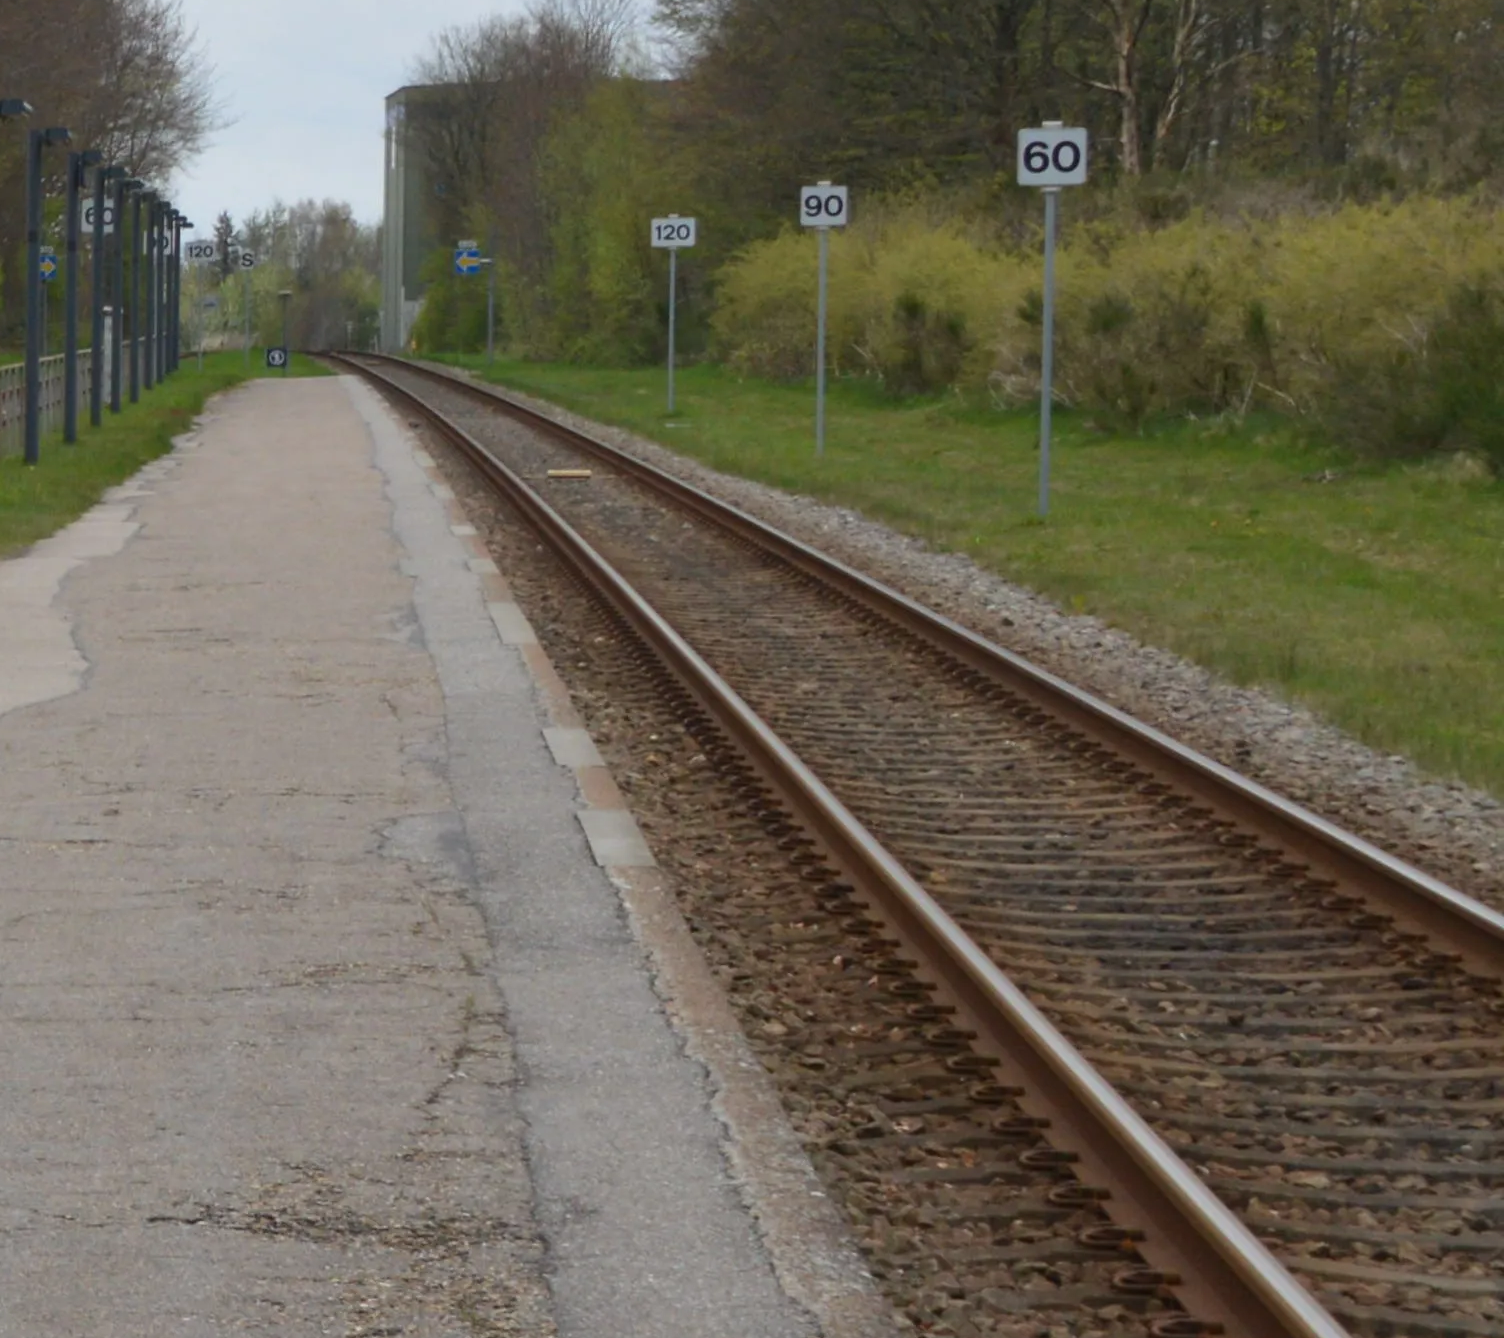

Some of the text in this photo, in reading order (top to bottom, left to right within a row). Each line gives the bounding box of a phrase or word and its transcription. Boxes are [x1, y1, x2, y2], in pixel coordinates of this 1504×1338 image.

[1023, 141, 1081, 173] 60
[804, 194, 844, 217] 90
[656, 224, 690, 241] 120
[189, 245, 214, 258] 120
[241, 253, 254, 267] S
